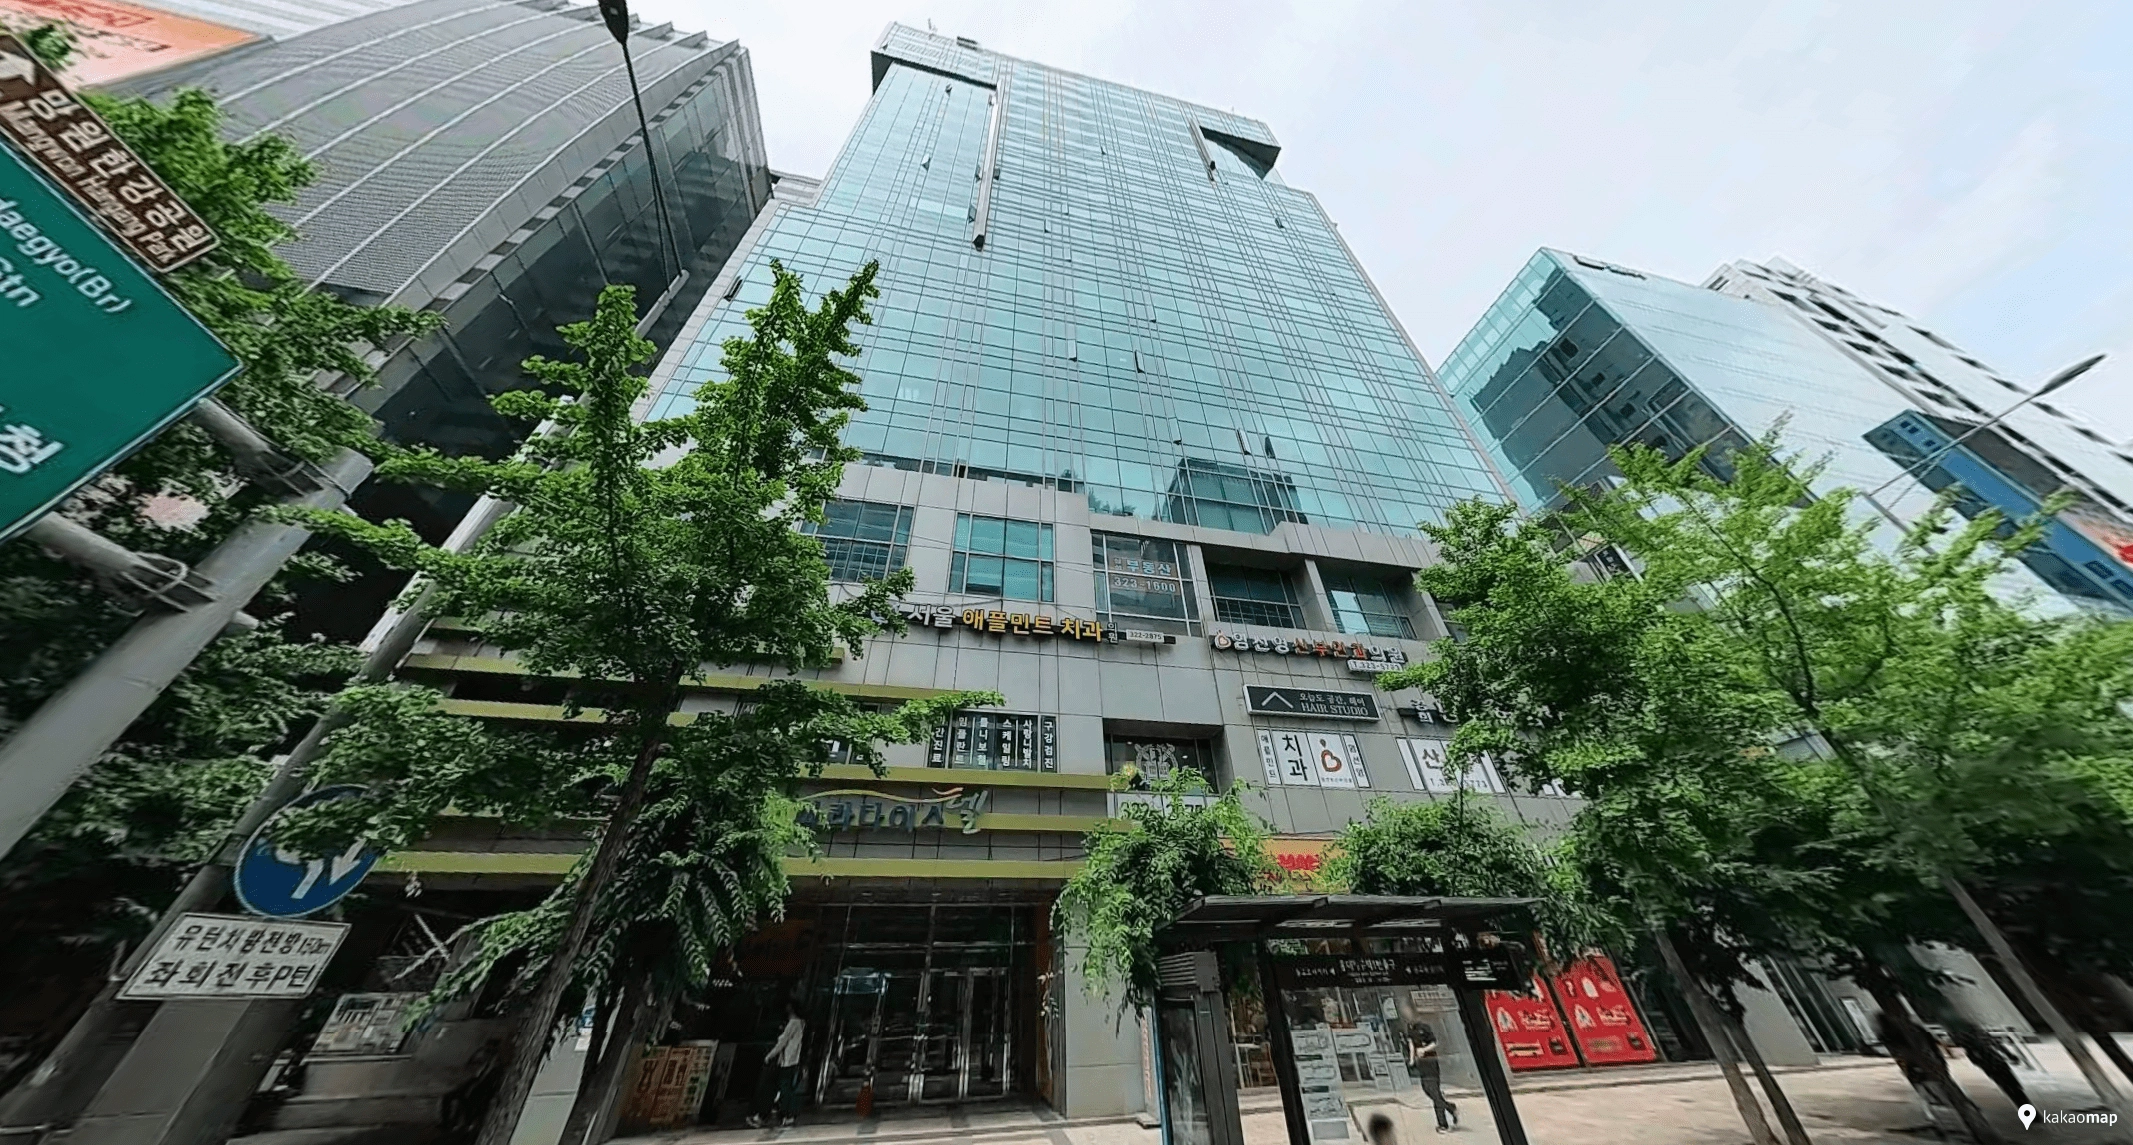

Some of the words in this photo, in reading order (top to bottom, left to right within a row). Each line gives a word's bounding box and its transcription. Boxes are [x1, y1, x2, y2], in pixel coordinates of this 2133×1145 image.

[28, 89, 212, 251] 망원한강공원
[138, 231, 177, 264] Park
[1114, 576, 1176, 593] 323-1600
[1126, 559, 1172, 576] 부동산
[907, 603, 956, 629] 서울
[962, 607, 1055, 636] 애플민트
[1060, 616, 1103, 643] 치과
[1300, 701, 1329, 714] HAIR
[1329, 704, 1369, 717] STUDIO
[954, 716, 968, 765] 임플란트
[1001, 718, 1013, 767] 스케일링
[1043, 720, 1054, 769] 구강검진
[1282, 734, 1308, 781] 치과
